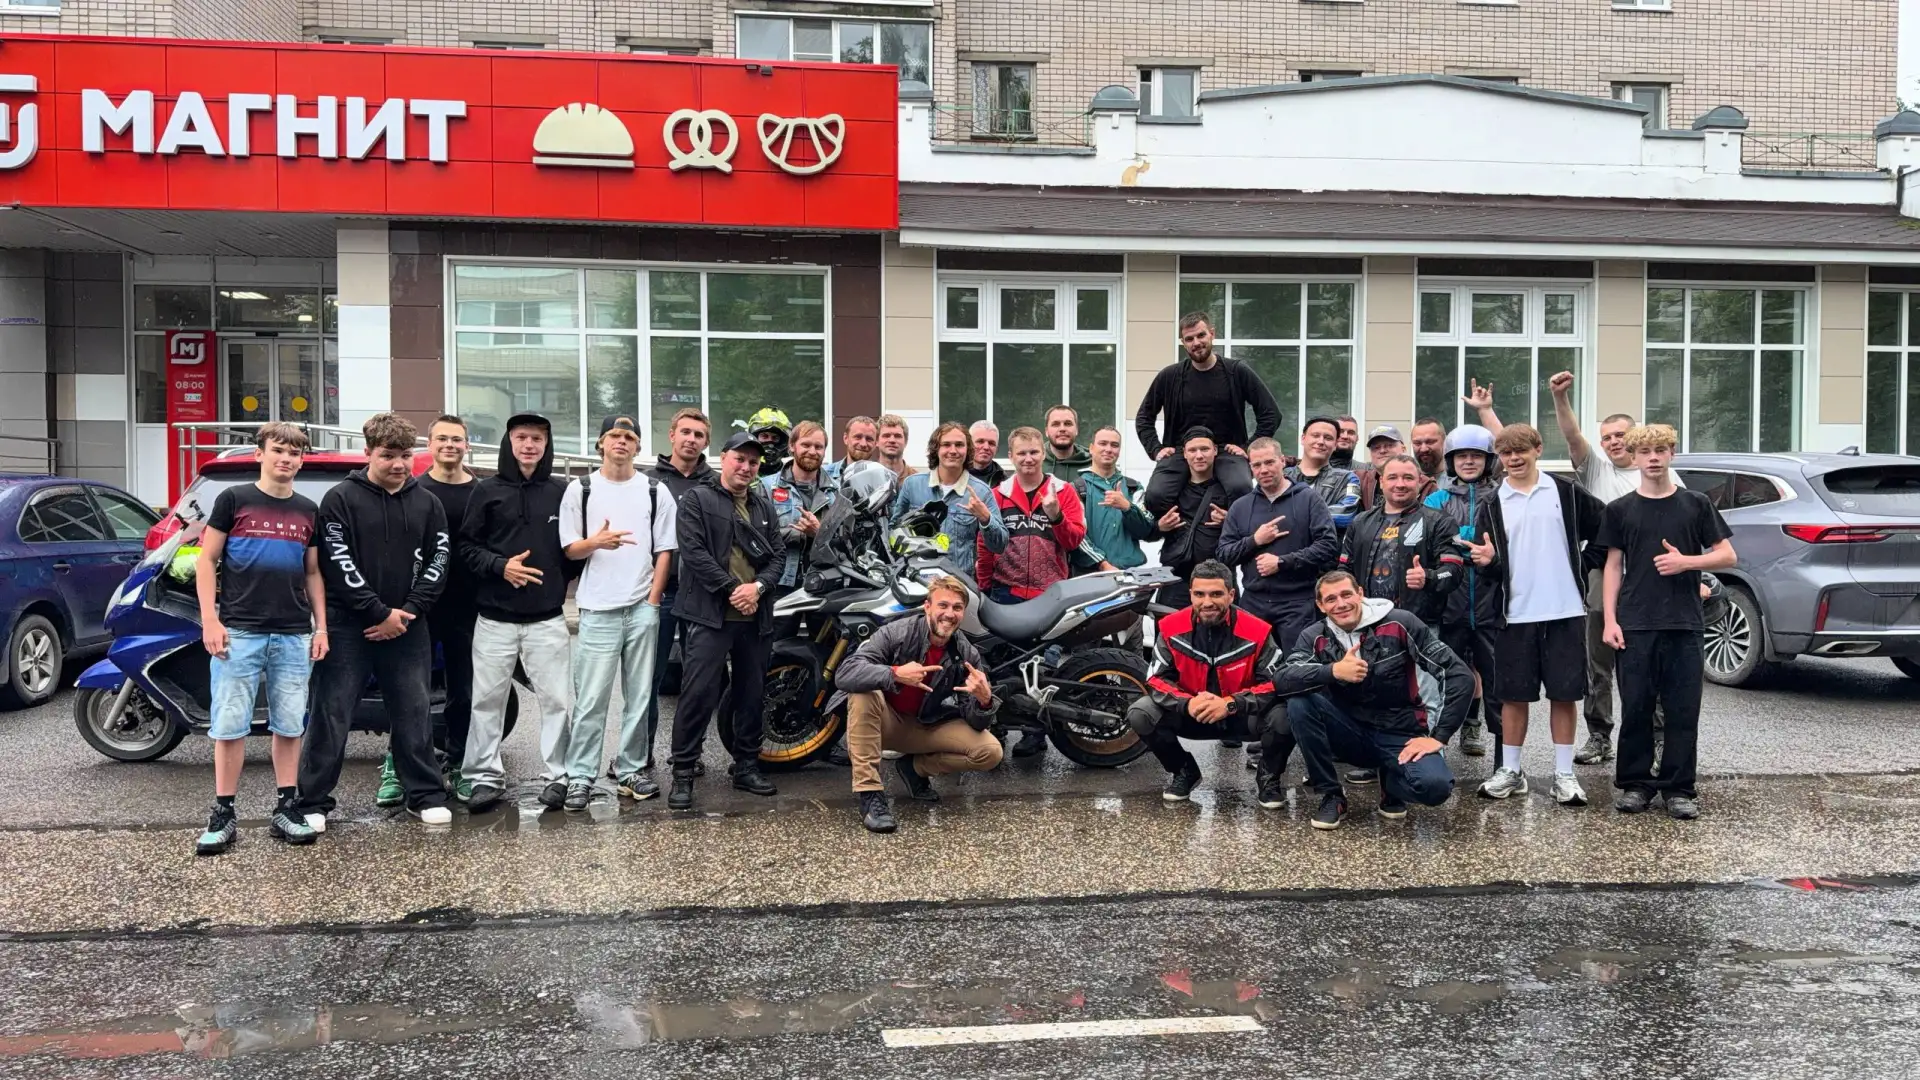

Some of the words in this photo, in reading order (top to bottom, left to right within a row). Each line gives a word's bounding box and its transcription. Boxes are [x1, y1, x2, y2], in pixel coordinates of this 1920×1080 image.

[82, 89, 467, 163] МАГНИТ
[250, 520, 307, 532] TOMMY
[325, 522, 365, 588] Calvin
